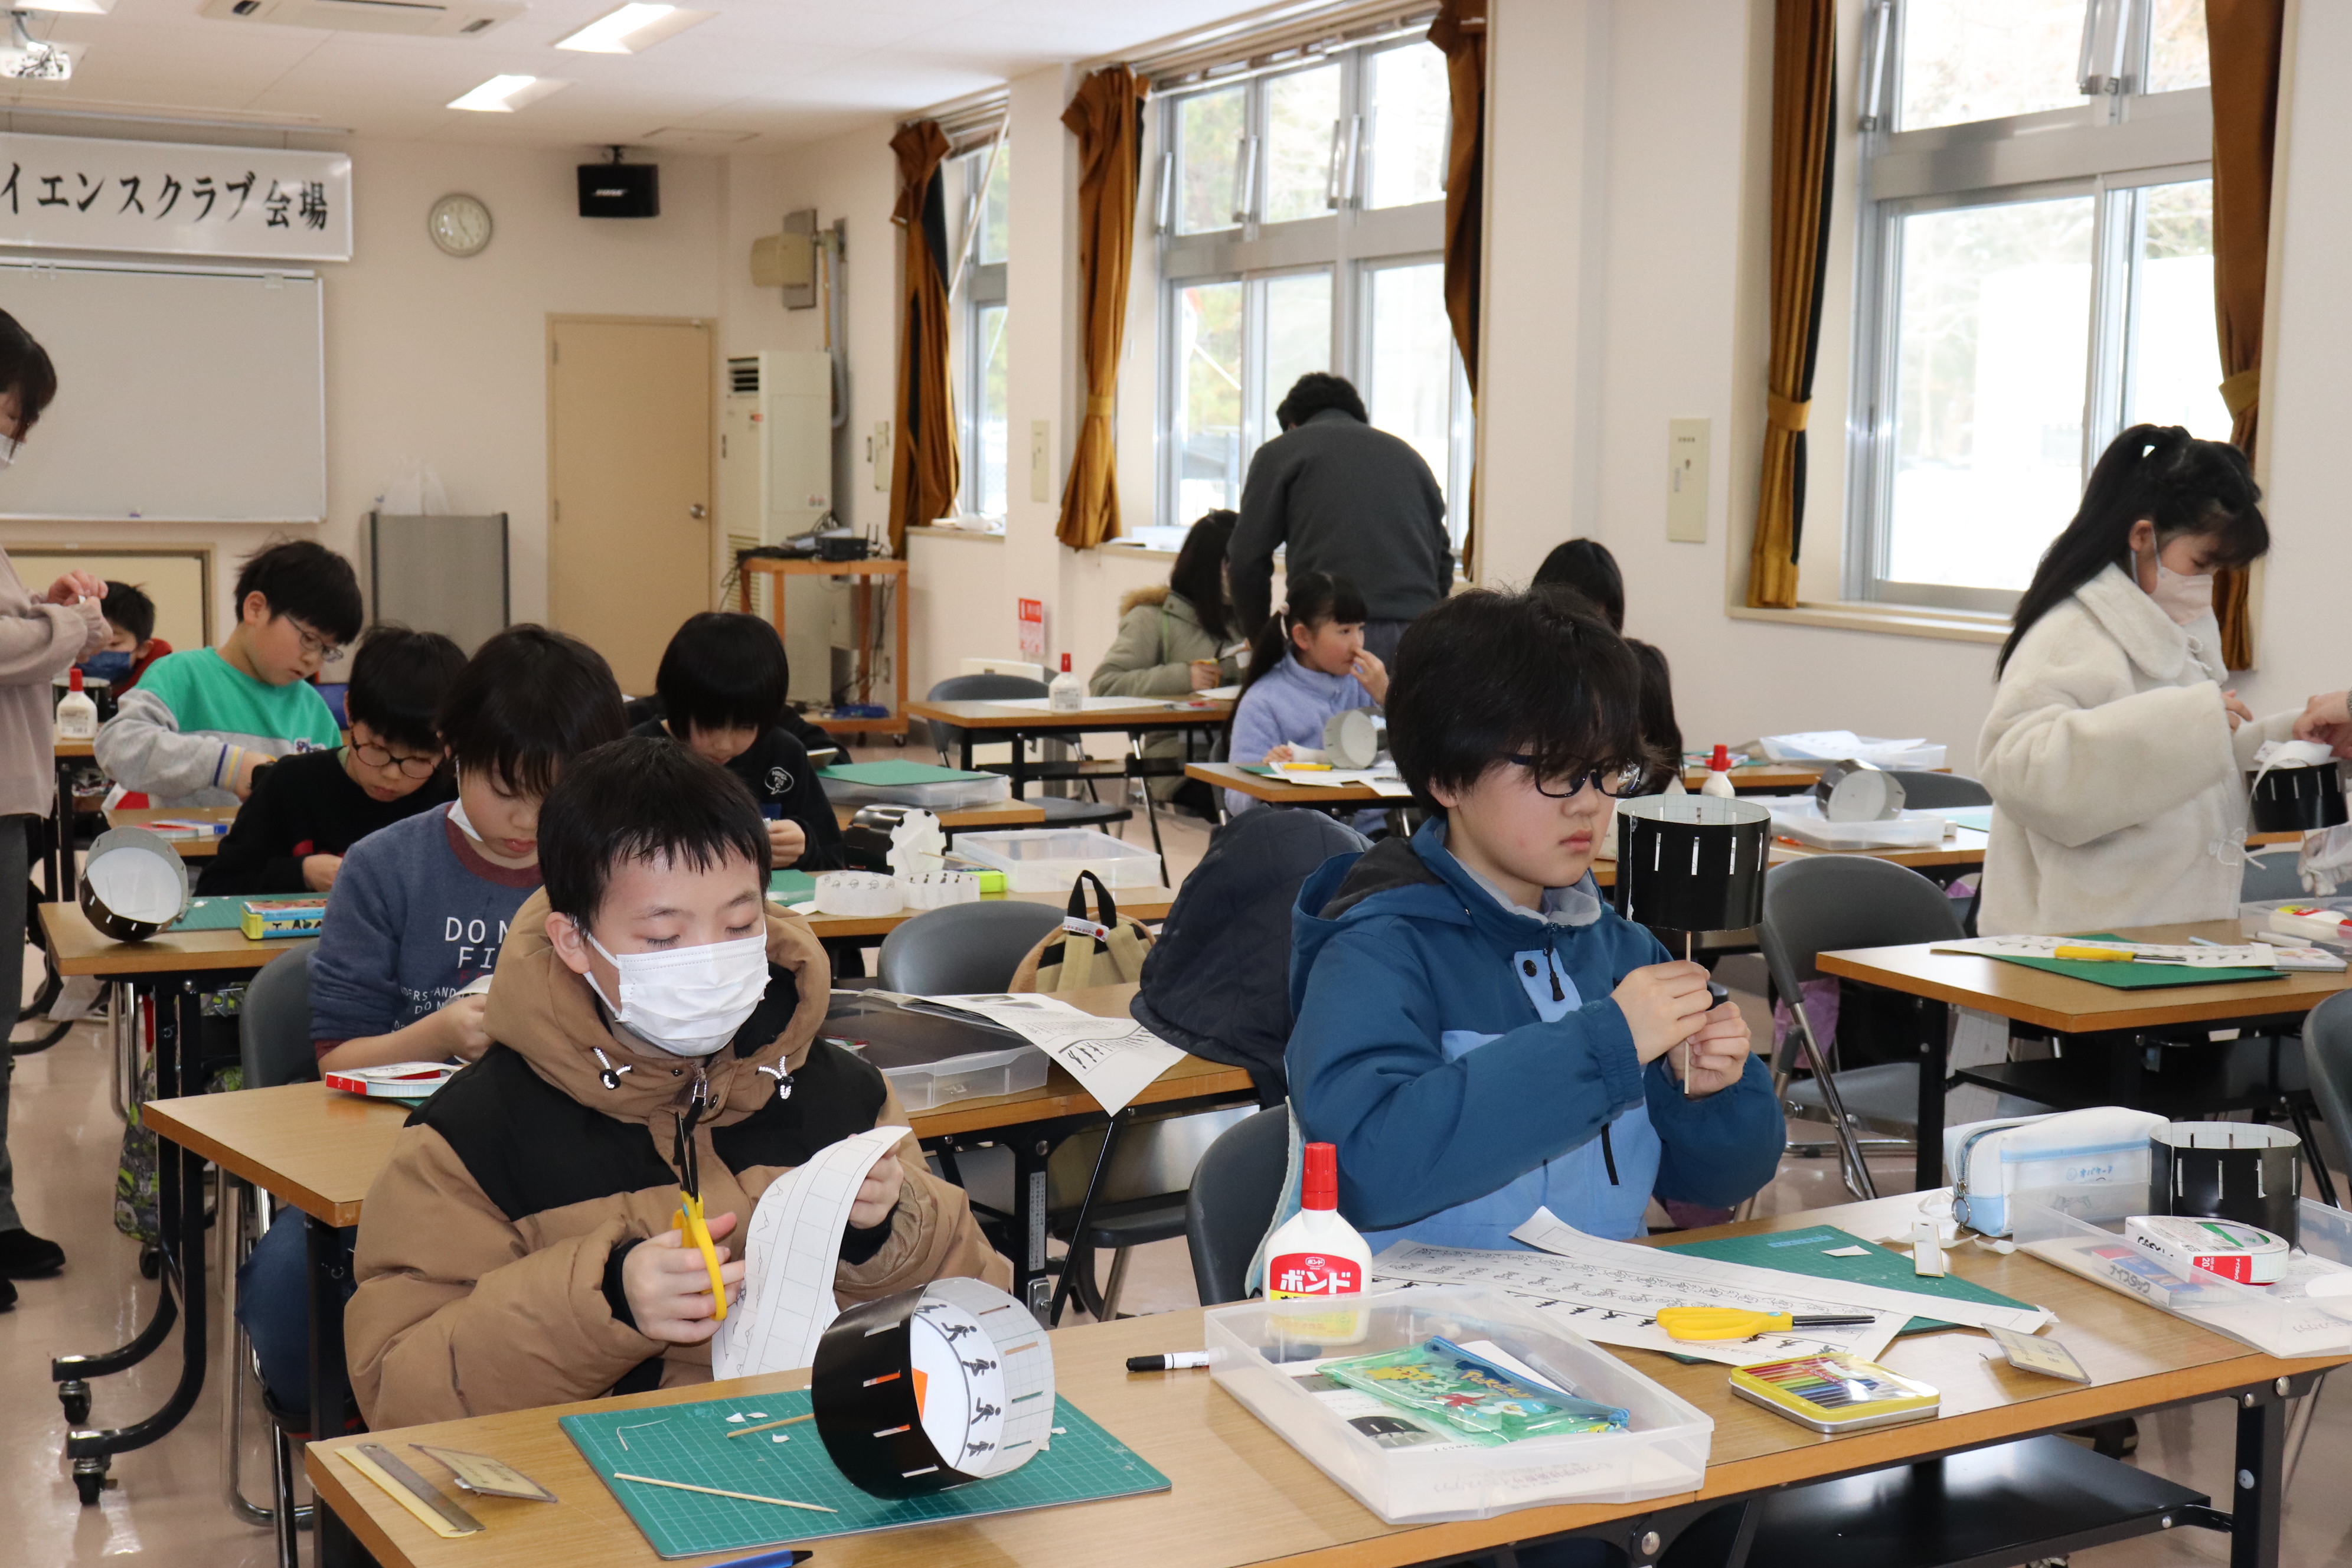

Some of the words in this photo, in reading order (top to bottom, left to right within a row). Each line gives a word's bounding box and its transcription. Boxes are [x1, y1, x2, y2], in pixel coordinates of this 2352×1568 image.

[1280, 1269, 1351, 1293] ボンド
[2109, 1265, 2150, 1294] ナイスタック
